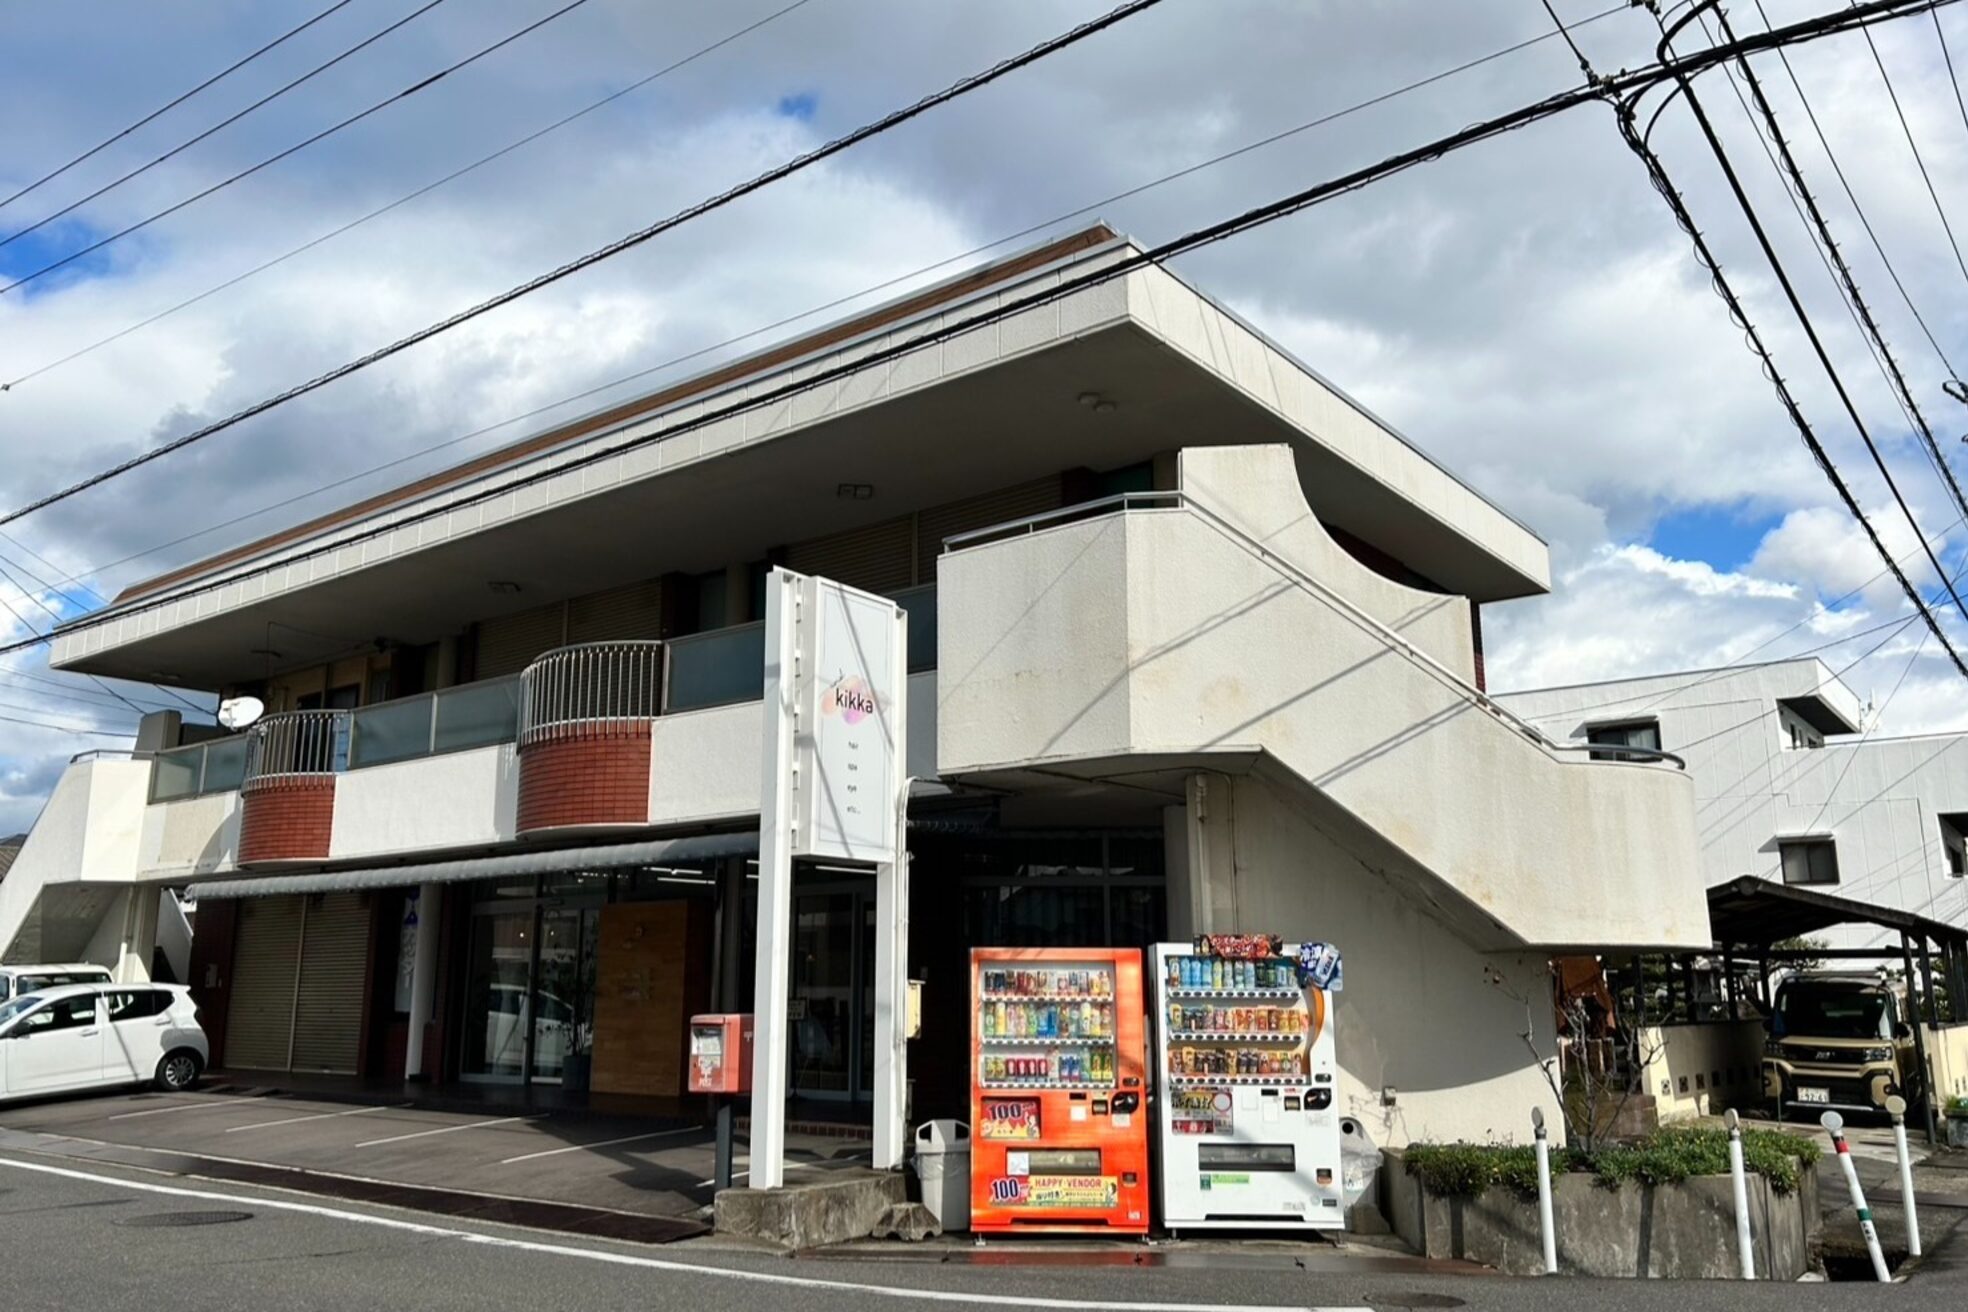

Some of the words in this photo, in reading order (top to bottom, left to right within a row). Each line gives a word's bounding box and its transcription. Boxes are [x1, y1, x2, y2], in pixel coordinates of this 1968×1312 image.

[835, 687, 873, 714] kikka
[988, 1102, 1022, 1120] 100
[992, 1179, 1019, 1200] 100
[1035, 1178, 1063, 1188] HAPPY
[1067, 1178, 1102, 1189] VENDOR
